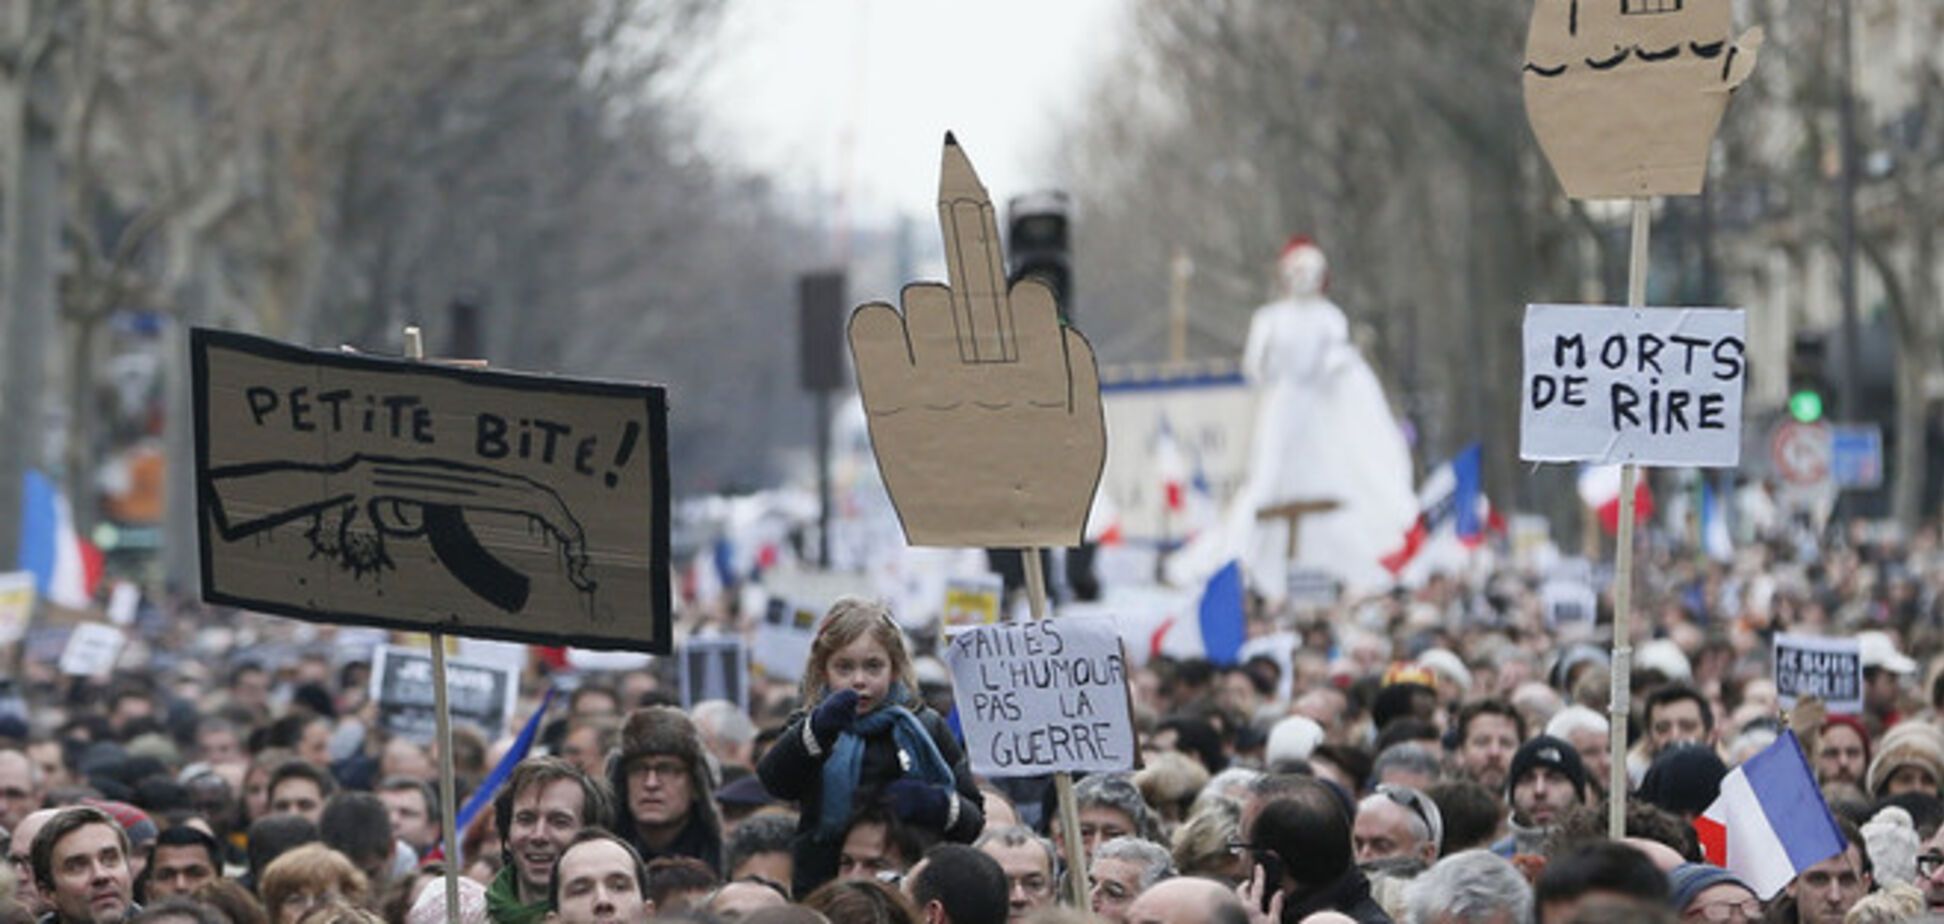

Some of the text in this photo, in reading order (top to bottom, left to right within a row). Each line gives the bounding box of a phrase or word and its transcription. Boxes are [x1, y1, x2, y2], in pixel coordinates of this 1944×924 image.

[1555, 333, 1745, 380] MORTS
[1531, 374, 1588, 410] DE
[956, 620, 1063, 658] FAITES
[980, 655, 1122, 691] L'HUMOUR
[1802, 652, 1854, 673] SUIS
[973, 690, 1093, 721] PAS LA
[991, 723, 1119, 767] GUERRE
